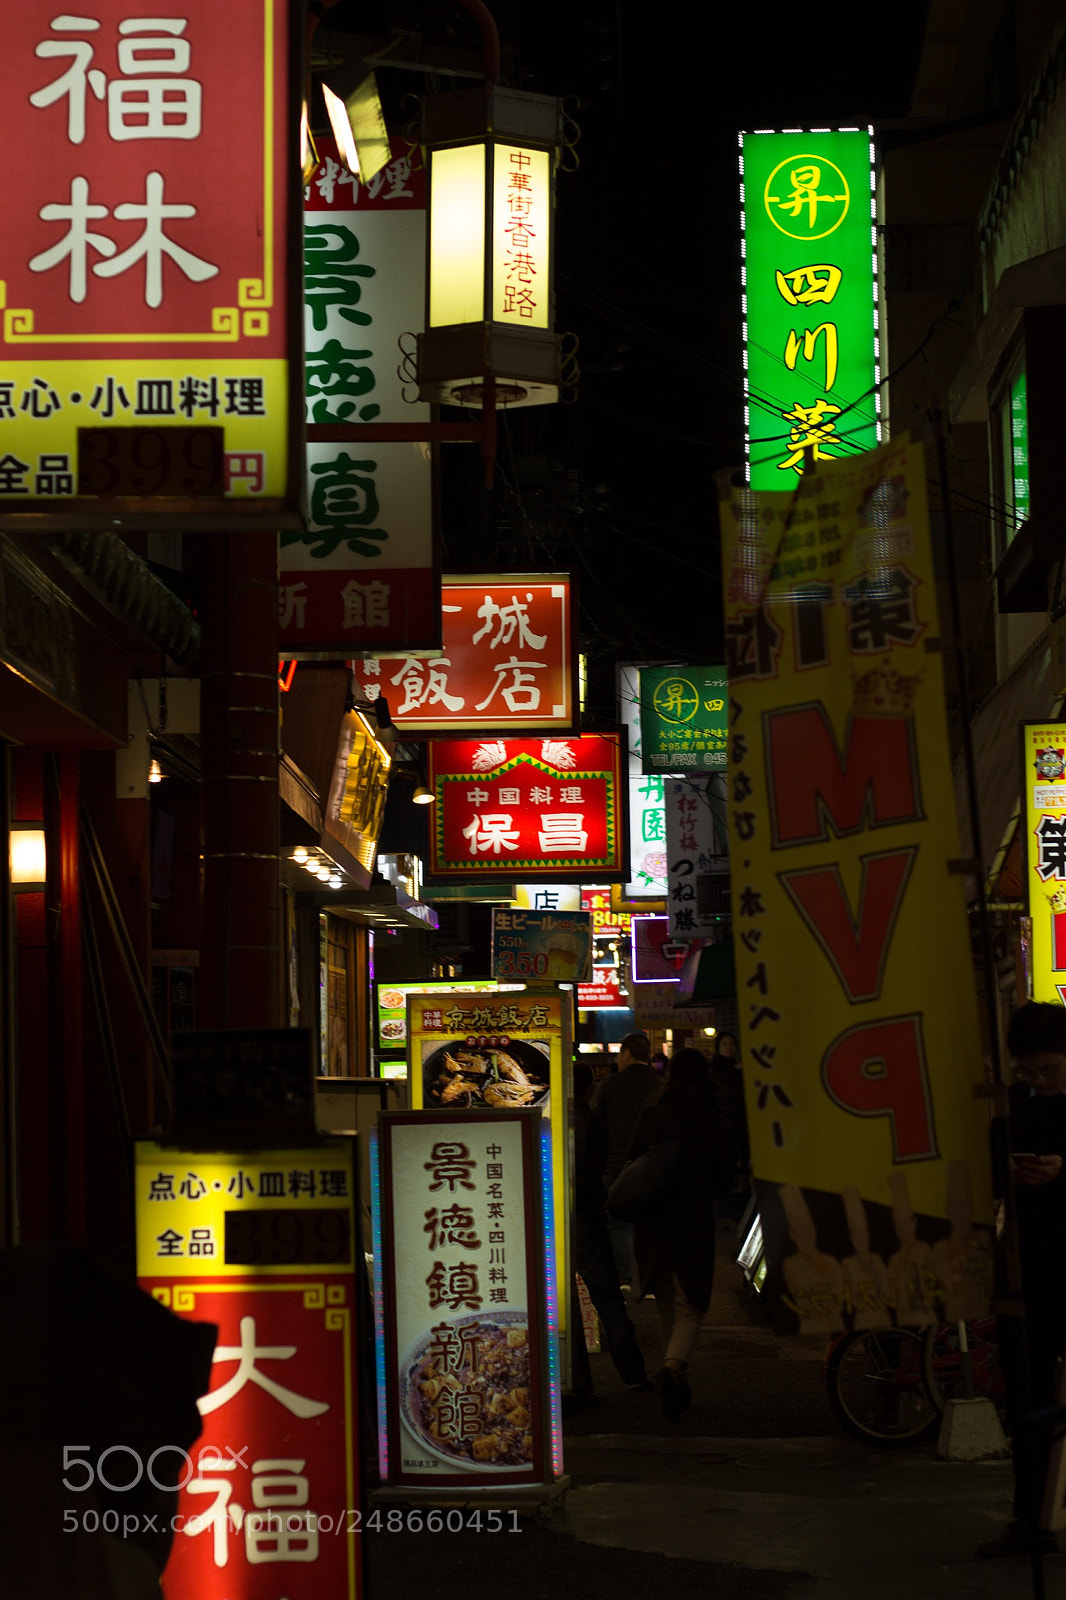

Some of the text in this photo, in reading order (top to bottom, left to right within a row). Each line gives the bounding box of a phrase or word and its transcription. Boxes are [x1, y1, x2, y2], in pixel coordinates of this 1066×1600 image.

[776, 163, 839, 231] 昇
[502, 151, 540, 321] 中華街香港路
[390, 656, 549, 716] 飯店
[703, 698, 725, 712] 四
[650, 752, 698, 767] TEL/FAX
[465, 786, 586, 806] 中国料理
[461, 812, 590, 855] 保昌
[445, 1004, 551, 1029] 京城飯店
[149, 1170, 348, 1201] 点心・小皿料理
[485, 1142, 509, 1304] 中国名菜・四川料理
[424, 1142, 485, 1443] 景徳鎮新館
